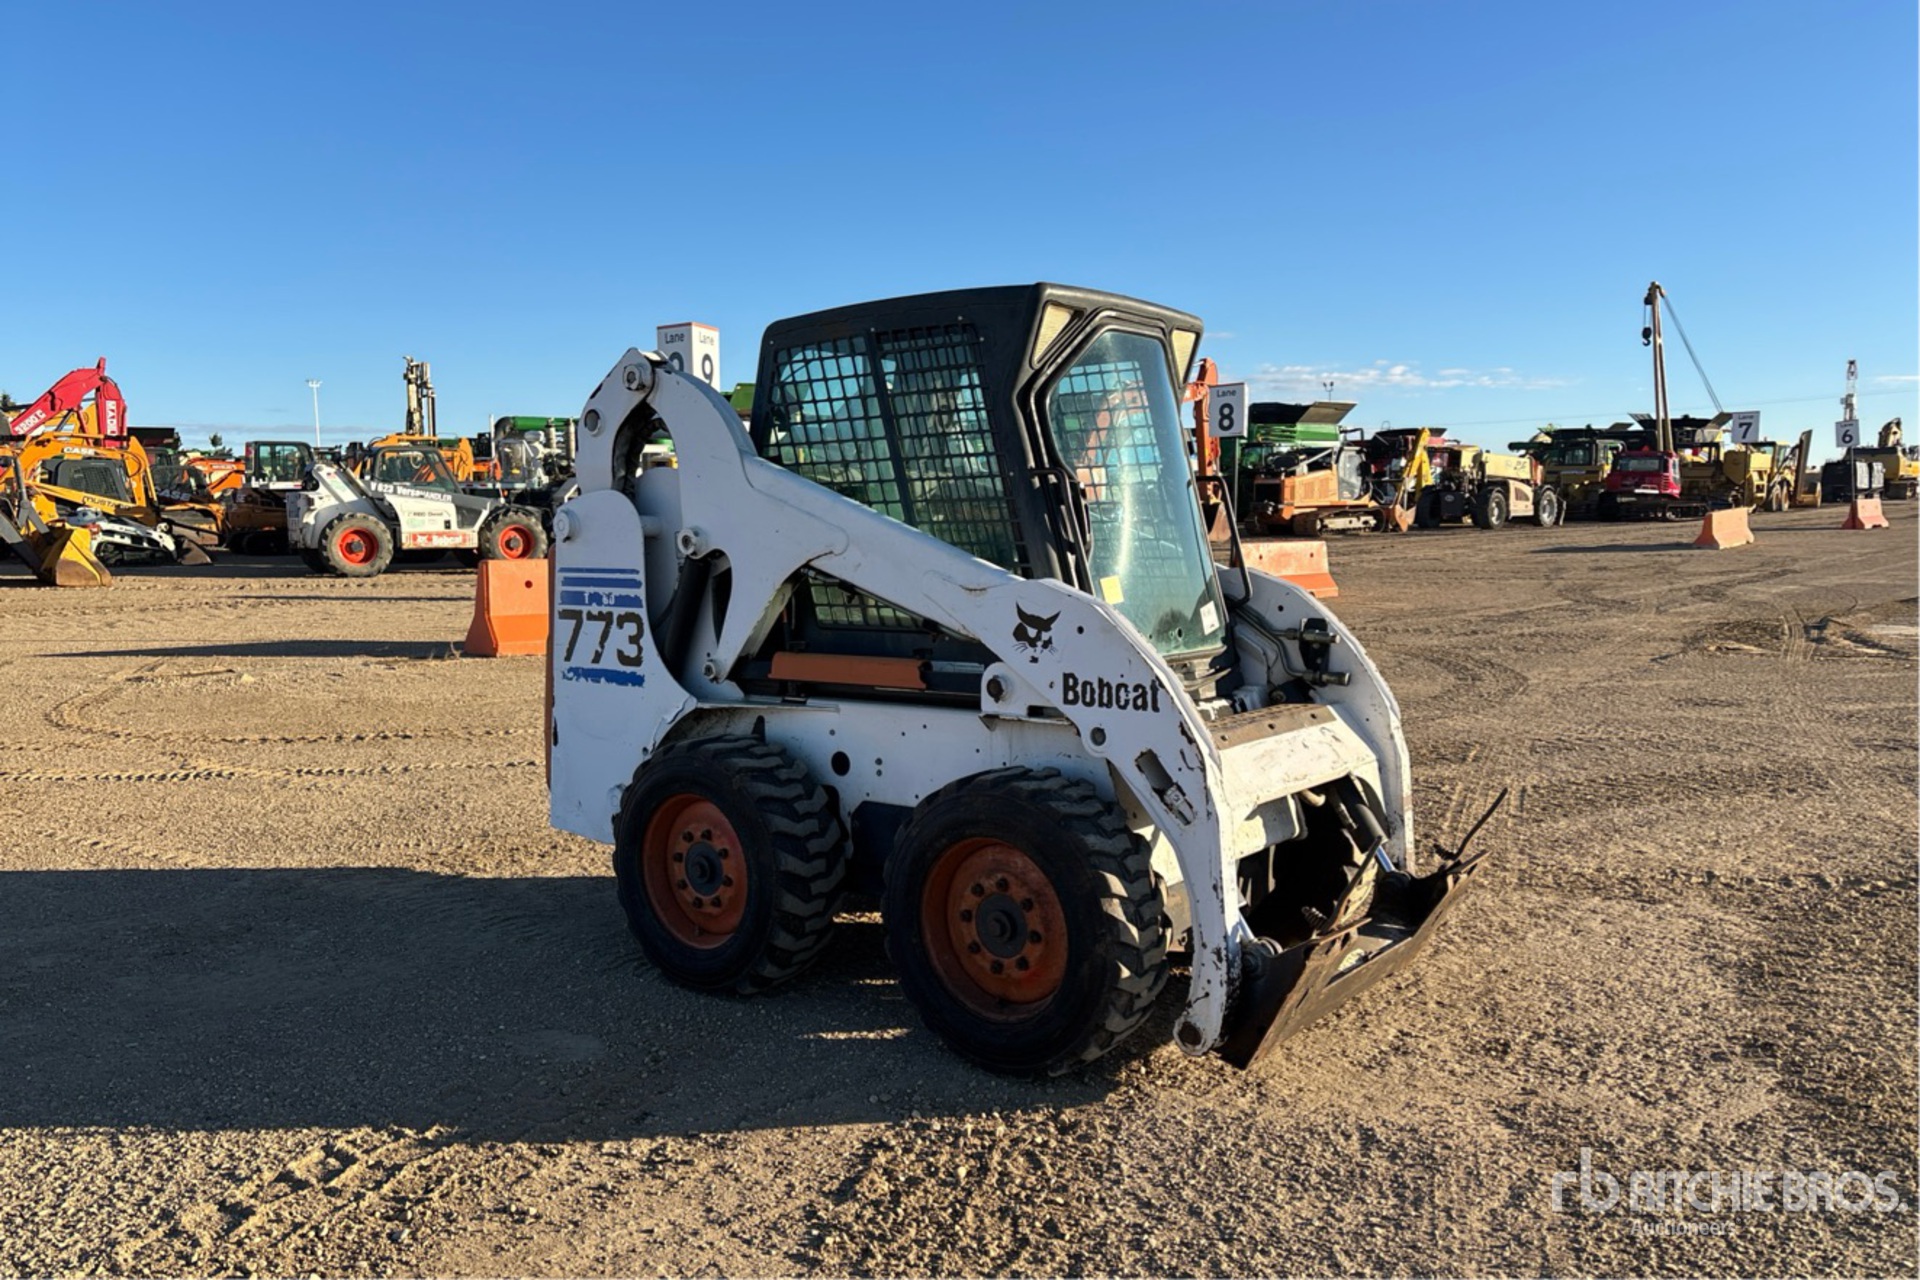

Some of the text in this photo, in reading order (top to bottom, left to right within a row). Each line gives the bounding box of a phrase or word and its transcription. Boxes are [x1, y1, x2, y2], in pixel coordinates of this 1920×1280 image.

[664, 332, 685, 344] Lane
[698, 331, 715, 346] Lane
[701, 353, 713, 386] 9
[1219, 403, 1234, 431] 8
[1738, 422, 1753, 439] 7
[1841, 429, 1853, 444] 6
[64, 447, 96, 455] CASE
[558, 609, 645, 667] 773
[1062, 672, 1161, 713] Bobcat
